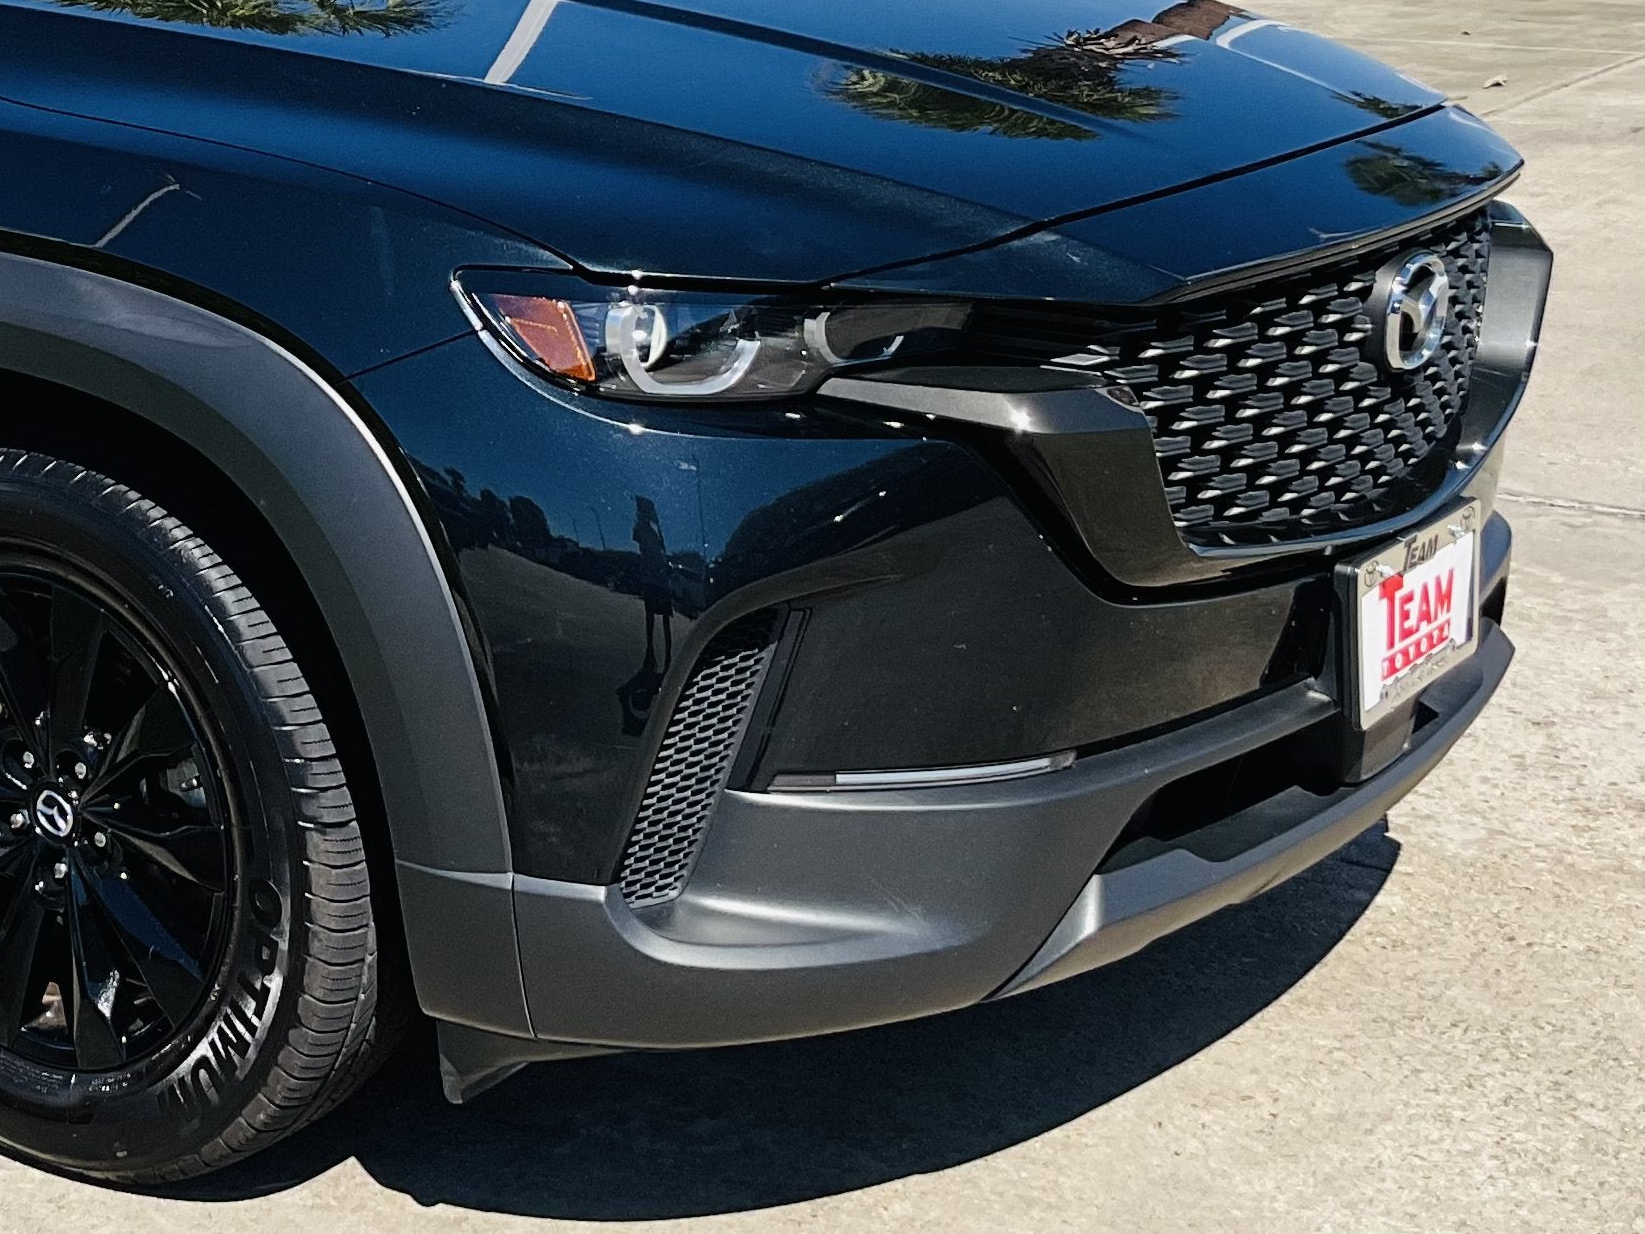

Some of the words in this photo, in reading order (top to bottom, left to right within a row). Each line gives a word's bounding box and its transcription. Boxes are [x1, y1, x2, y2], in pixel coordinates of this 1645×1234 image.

[1404, 533, 1439, 574] TEAM
[1378, 566, 1455, 651] TEAM
[1382, 621, 1450, 677] TOYOTA
